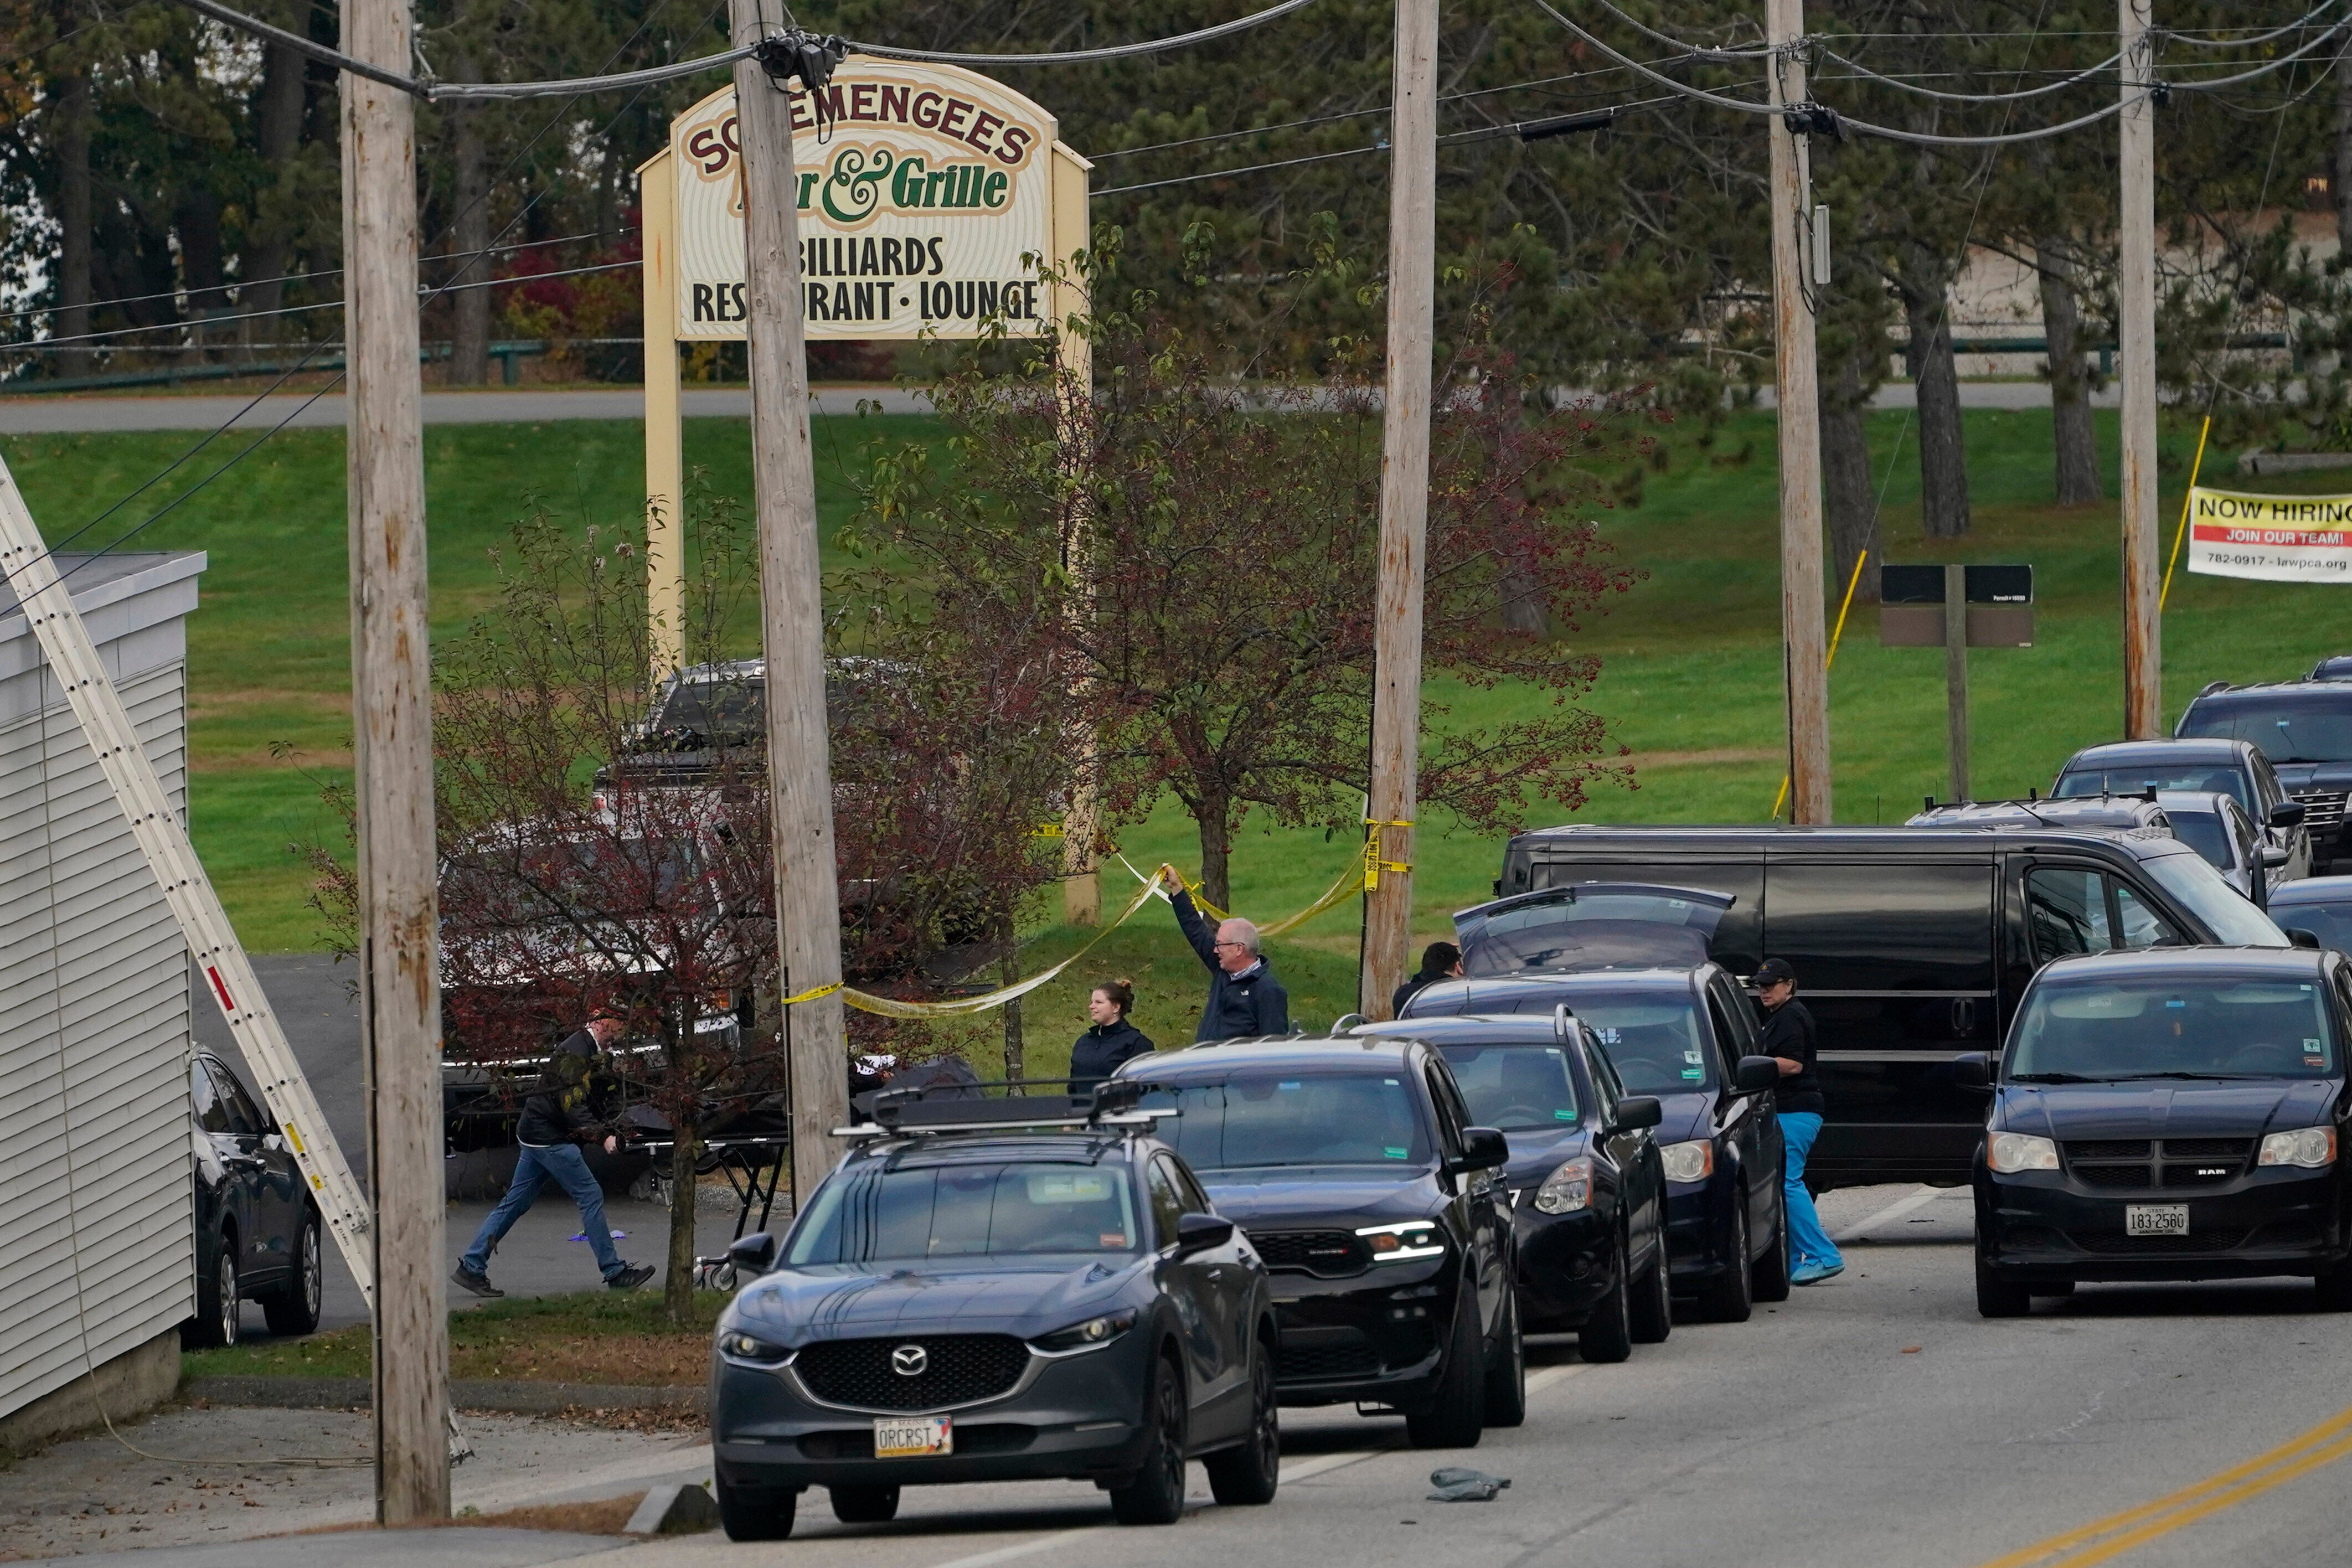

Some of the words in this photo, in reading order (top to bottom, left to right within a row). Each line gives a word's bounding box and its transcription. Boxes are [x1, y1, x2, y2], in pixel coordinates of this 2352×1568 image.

[891, 157, 1007, 208] Grille
[920, 281, 1038, 320] LOUNGE
[2200, 498, 2263, 519] NOW
[2226, 529, 2260, 543] JOIN
[2265, 530, 2296, 544] OUR
[2297, 532, 2344, 545] TEAM!
[2208, 553, 2265, 566] 782-0917
[2277, 558, 2347, 571] lawpca.org
